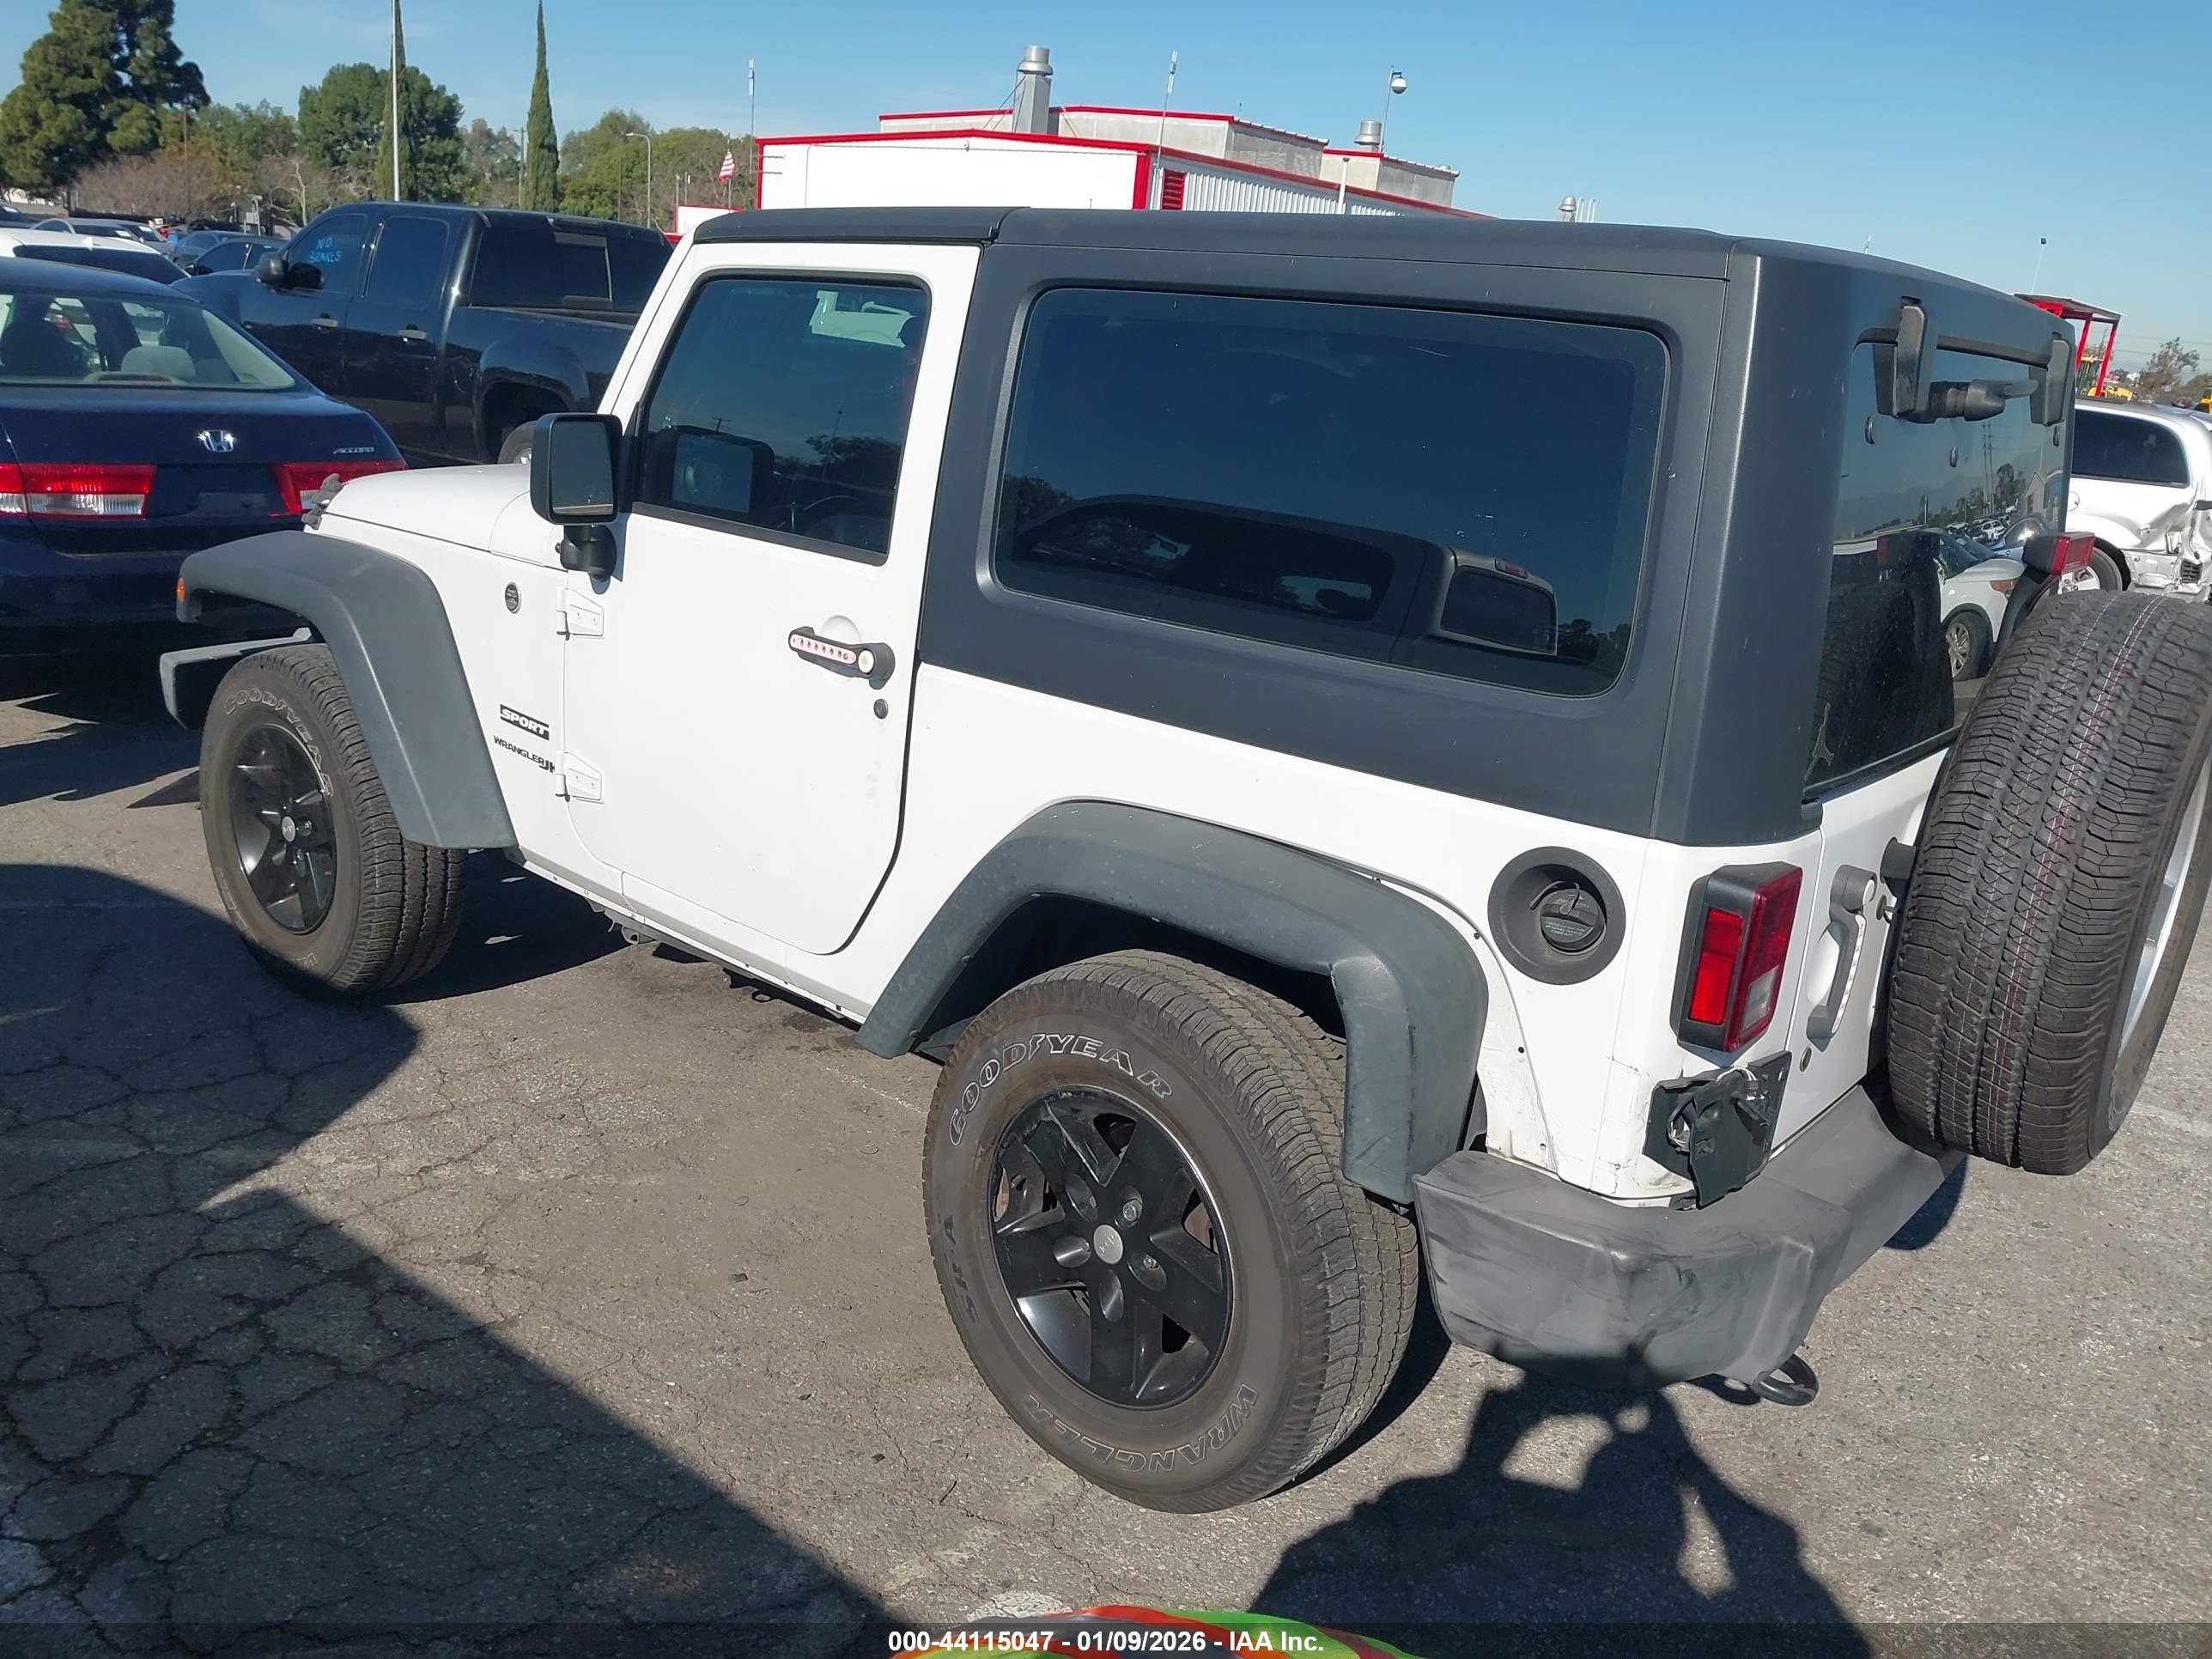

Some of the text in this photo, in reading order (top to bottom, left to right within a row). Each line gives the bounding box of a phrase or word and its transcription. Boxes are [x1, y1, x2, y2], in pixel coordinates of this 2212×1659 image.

[317, 236, 333, 249] NO
[226, 687, 335, 797] GOODYEAR
[493, 735, 546, 767] WRANGLER
[501, 708, 550, 737] SPORT
[949, 1032, 1173, 1146] GOODYEAR
[1024, 1383, 1258, 1472] WRANGLER
